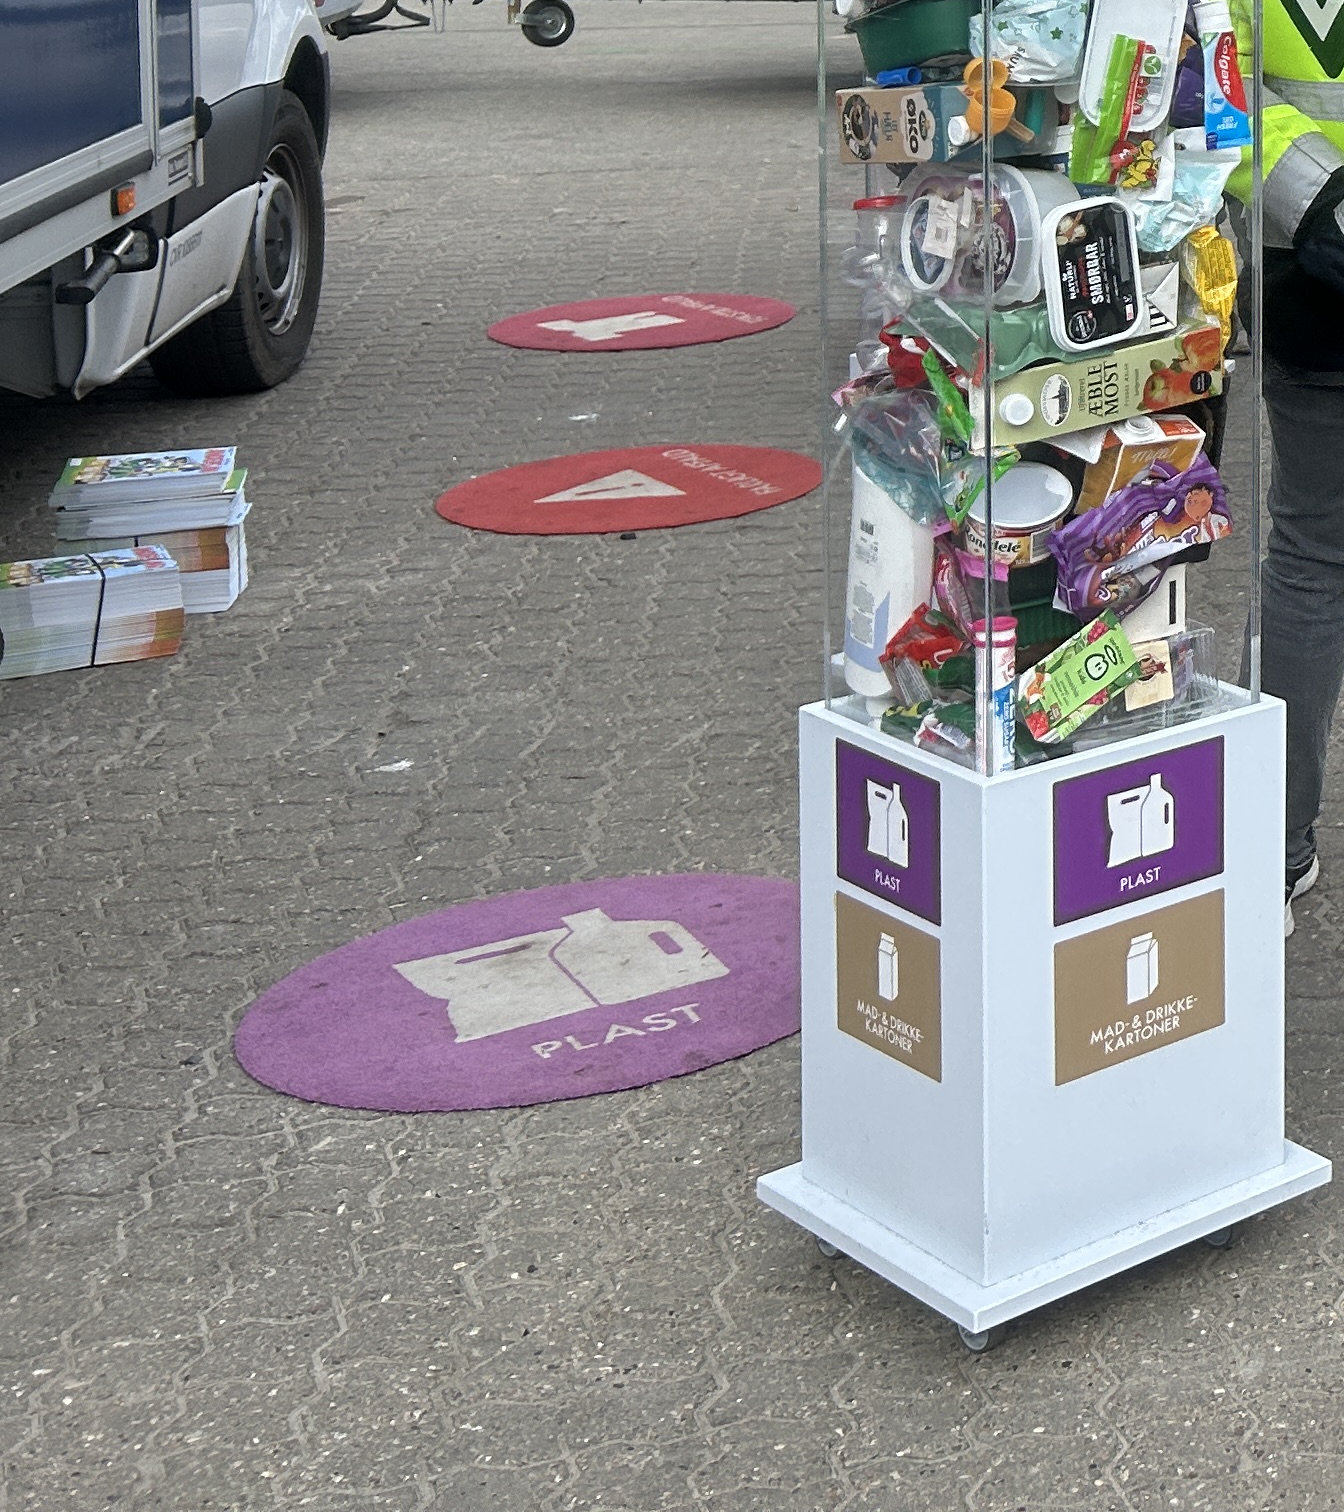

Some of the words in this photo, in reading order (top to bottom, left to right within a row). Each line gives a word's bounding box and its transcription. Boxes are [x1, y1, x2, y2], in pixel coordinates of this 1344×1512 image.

[1218, 35, 1233, 96] Colgate
[1085, 241, 1105, 306] SMØRBAR
[1087, 362, 1104, 419] ÆBLE
[1103, 359, 1120, 417] MOST
[874, 868, 901, 893] PLAST
[1120, 866, 1162, 892] PLAST
[530, 1002, 702, 1059] PLAST
[865, 1018, 913, 1054] KARTONER
[1090, 1019, 1130, 1045] MAD-
[1131, 1014, 1143, 1029] &
[1144, 995, 1199, 1025] DRIKKE-
[1104, 1015, 1181, 1054] KARTONER
